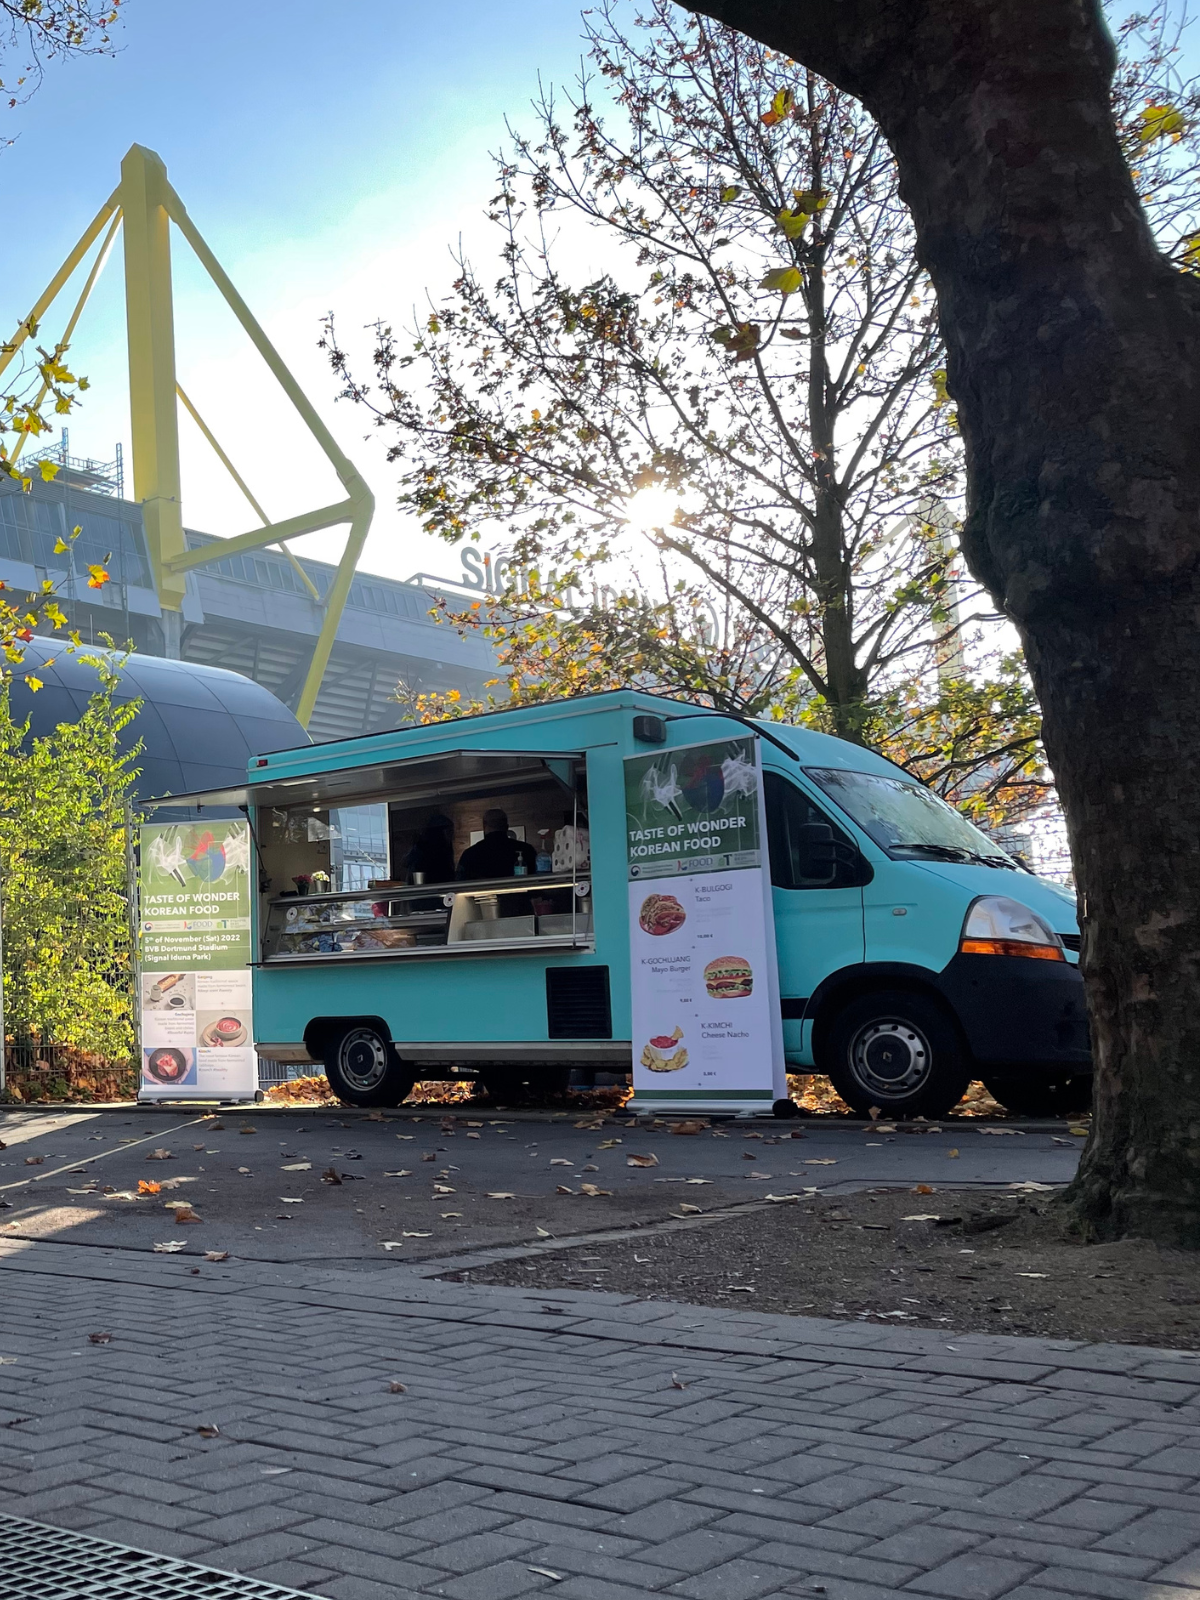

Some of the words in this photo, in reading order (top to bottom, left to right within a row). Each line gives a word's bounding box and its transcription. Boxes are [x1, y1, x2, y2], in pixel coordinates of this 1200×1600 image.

[629, 827, 664, 842] TASTE
[667, 824, 685, 836] OF
[687, 816, 746, 834] WONDER
[630, 841, 680, 857] KOREAN
[683, 836, 721, 851] FOOD
[695, 883, 733, 893] K-BULGOGI
[144, 895, 174, 904] TASTE
[176, 894, 190, 903] OF
[192, 892, 240, 902] WONDER
[144, 906, 187, 916] KOREAN
[189, 905, 220, 914] FOOD
[164, 935, 201, 943] November
[203, 934, 220, 943] (Sat)
[161, 944, 197, 952] Dortmund
[198, 943, 228, 951] Stadium
[144, 954, 169, 962] (Signal
[192, 953, 212, 961] Park)
[651, 966, 668, 974] Mayo
[670, 965, 691, 973] Burger
[727, 1030, 749, 1038] Nacho
